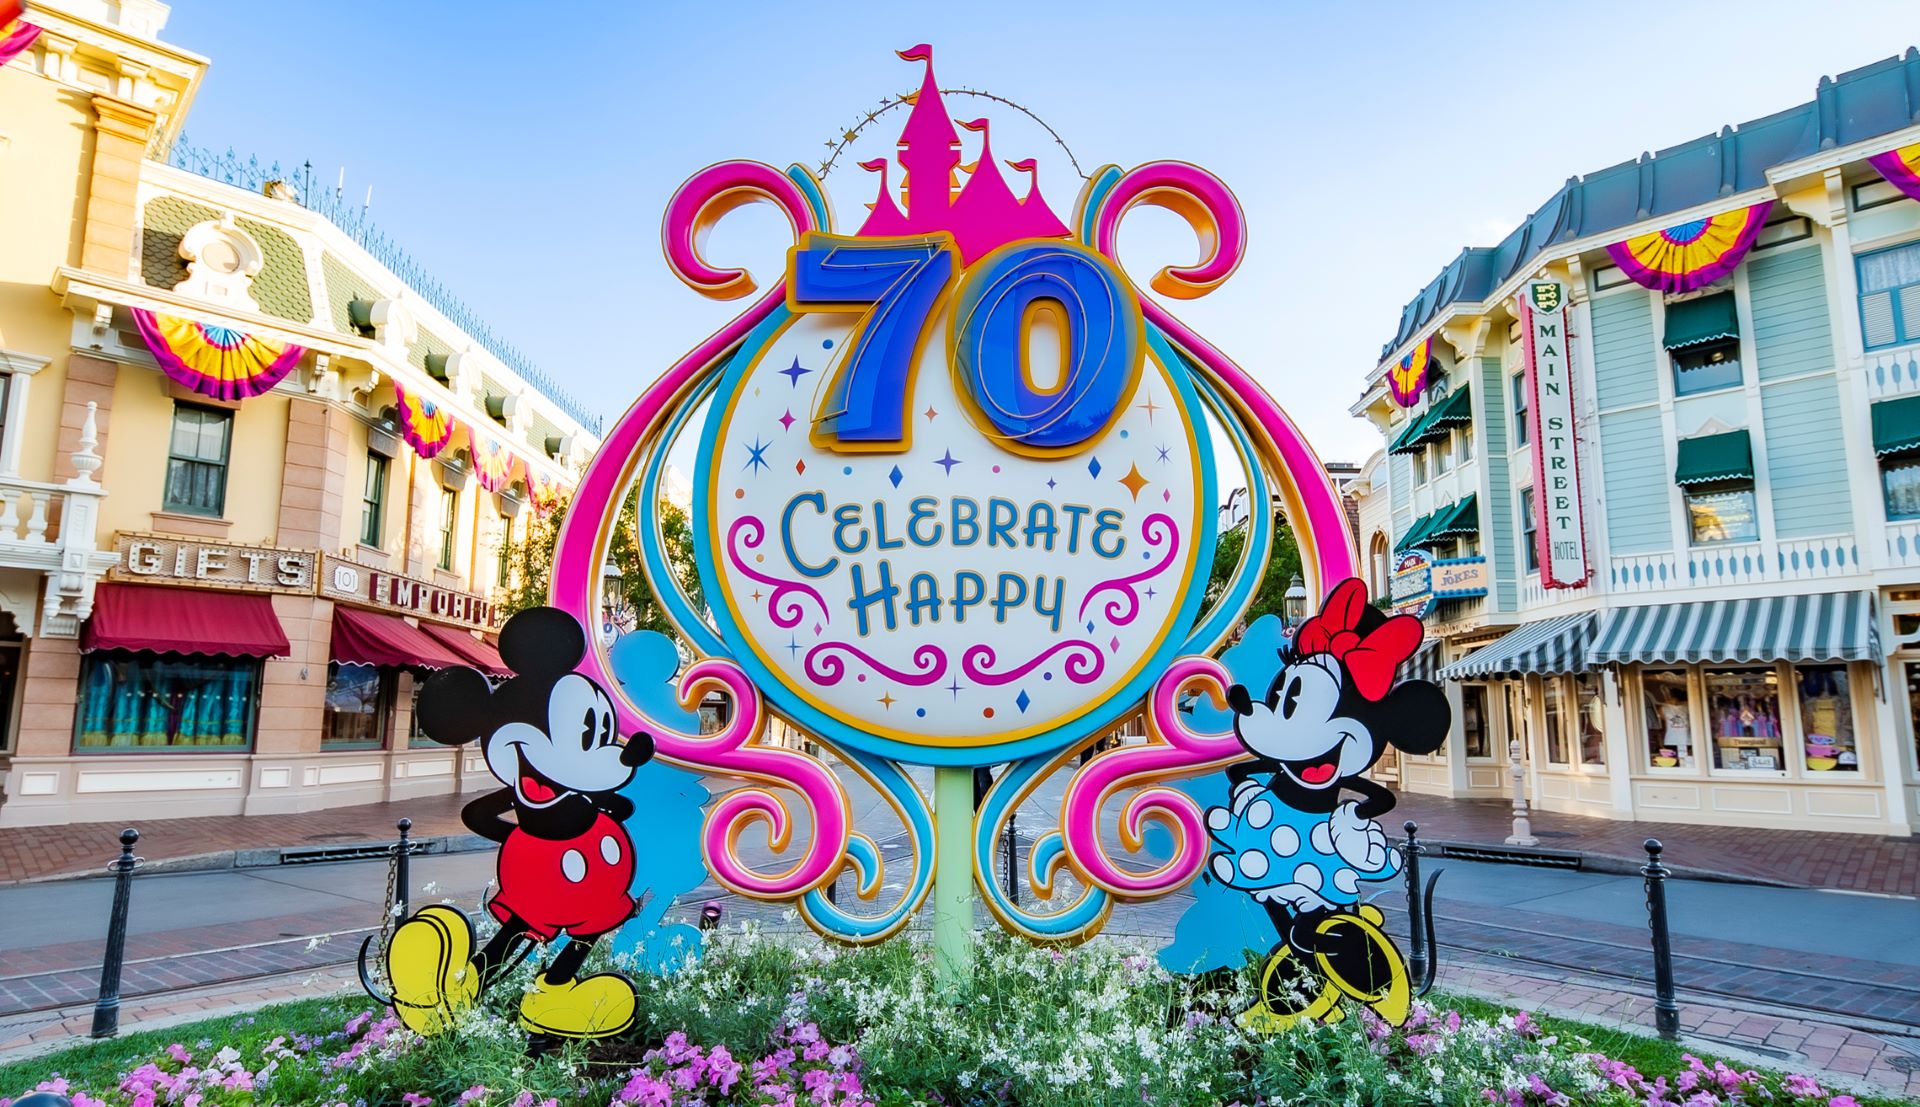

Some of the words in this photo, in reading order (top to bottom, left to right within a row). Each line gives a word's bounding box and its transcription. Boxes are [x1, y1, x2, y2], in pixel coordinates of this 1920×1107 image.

[787, 231, 1146, 459] 70
[1539, 325, 1560, 396] MAIN
[1548, 417, 1571, 530] STREET
[128, 542, 308, 586] GIFTS
[781, 490, 1126, 577] CELEBRATE
[1554, 541, 1580, 560] HOTEL
[338, 570, 356, 589] 101
[847, 560, 1067, 638] HAPPY
[1441, 569, 1479, 586] JOKES
